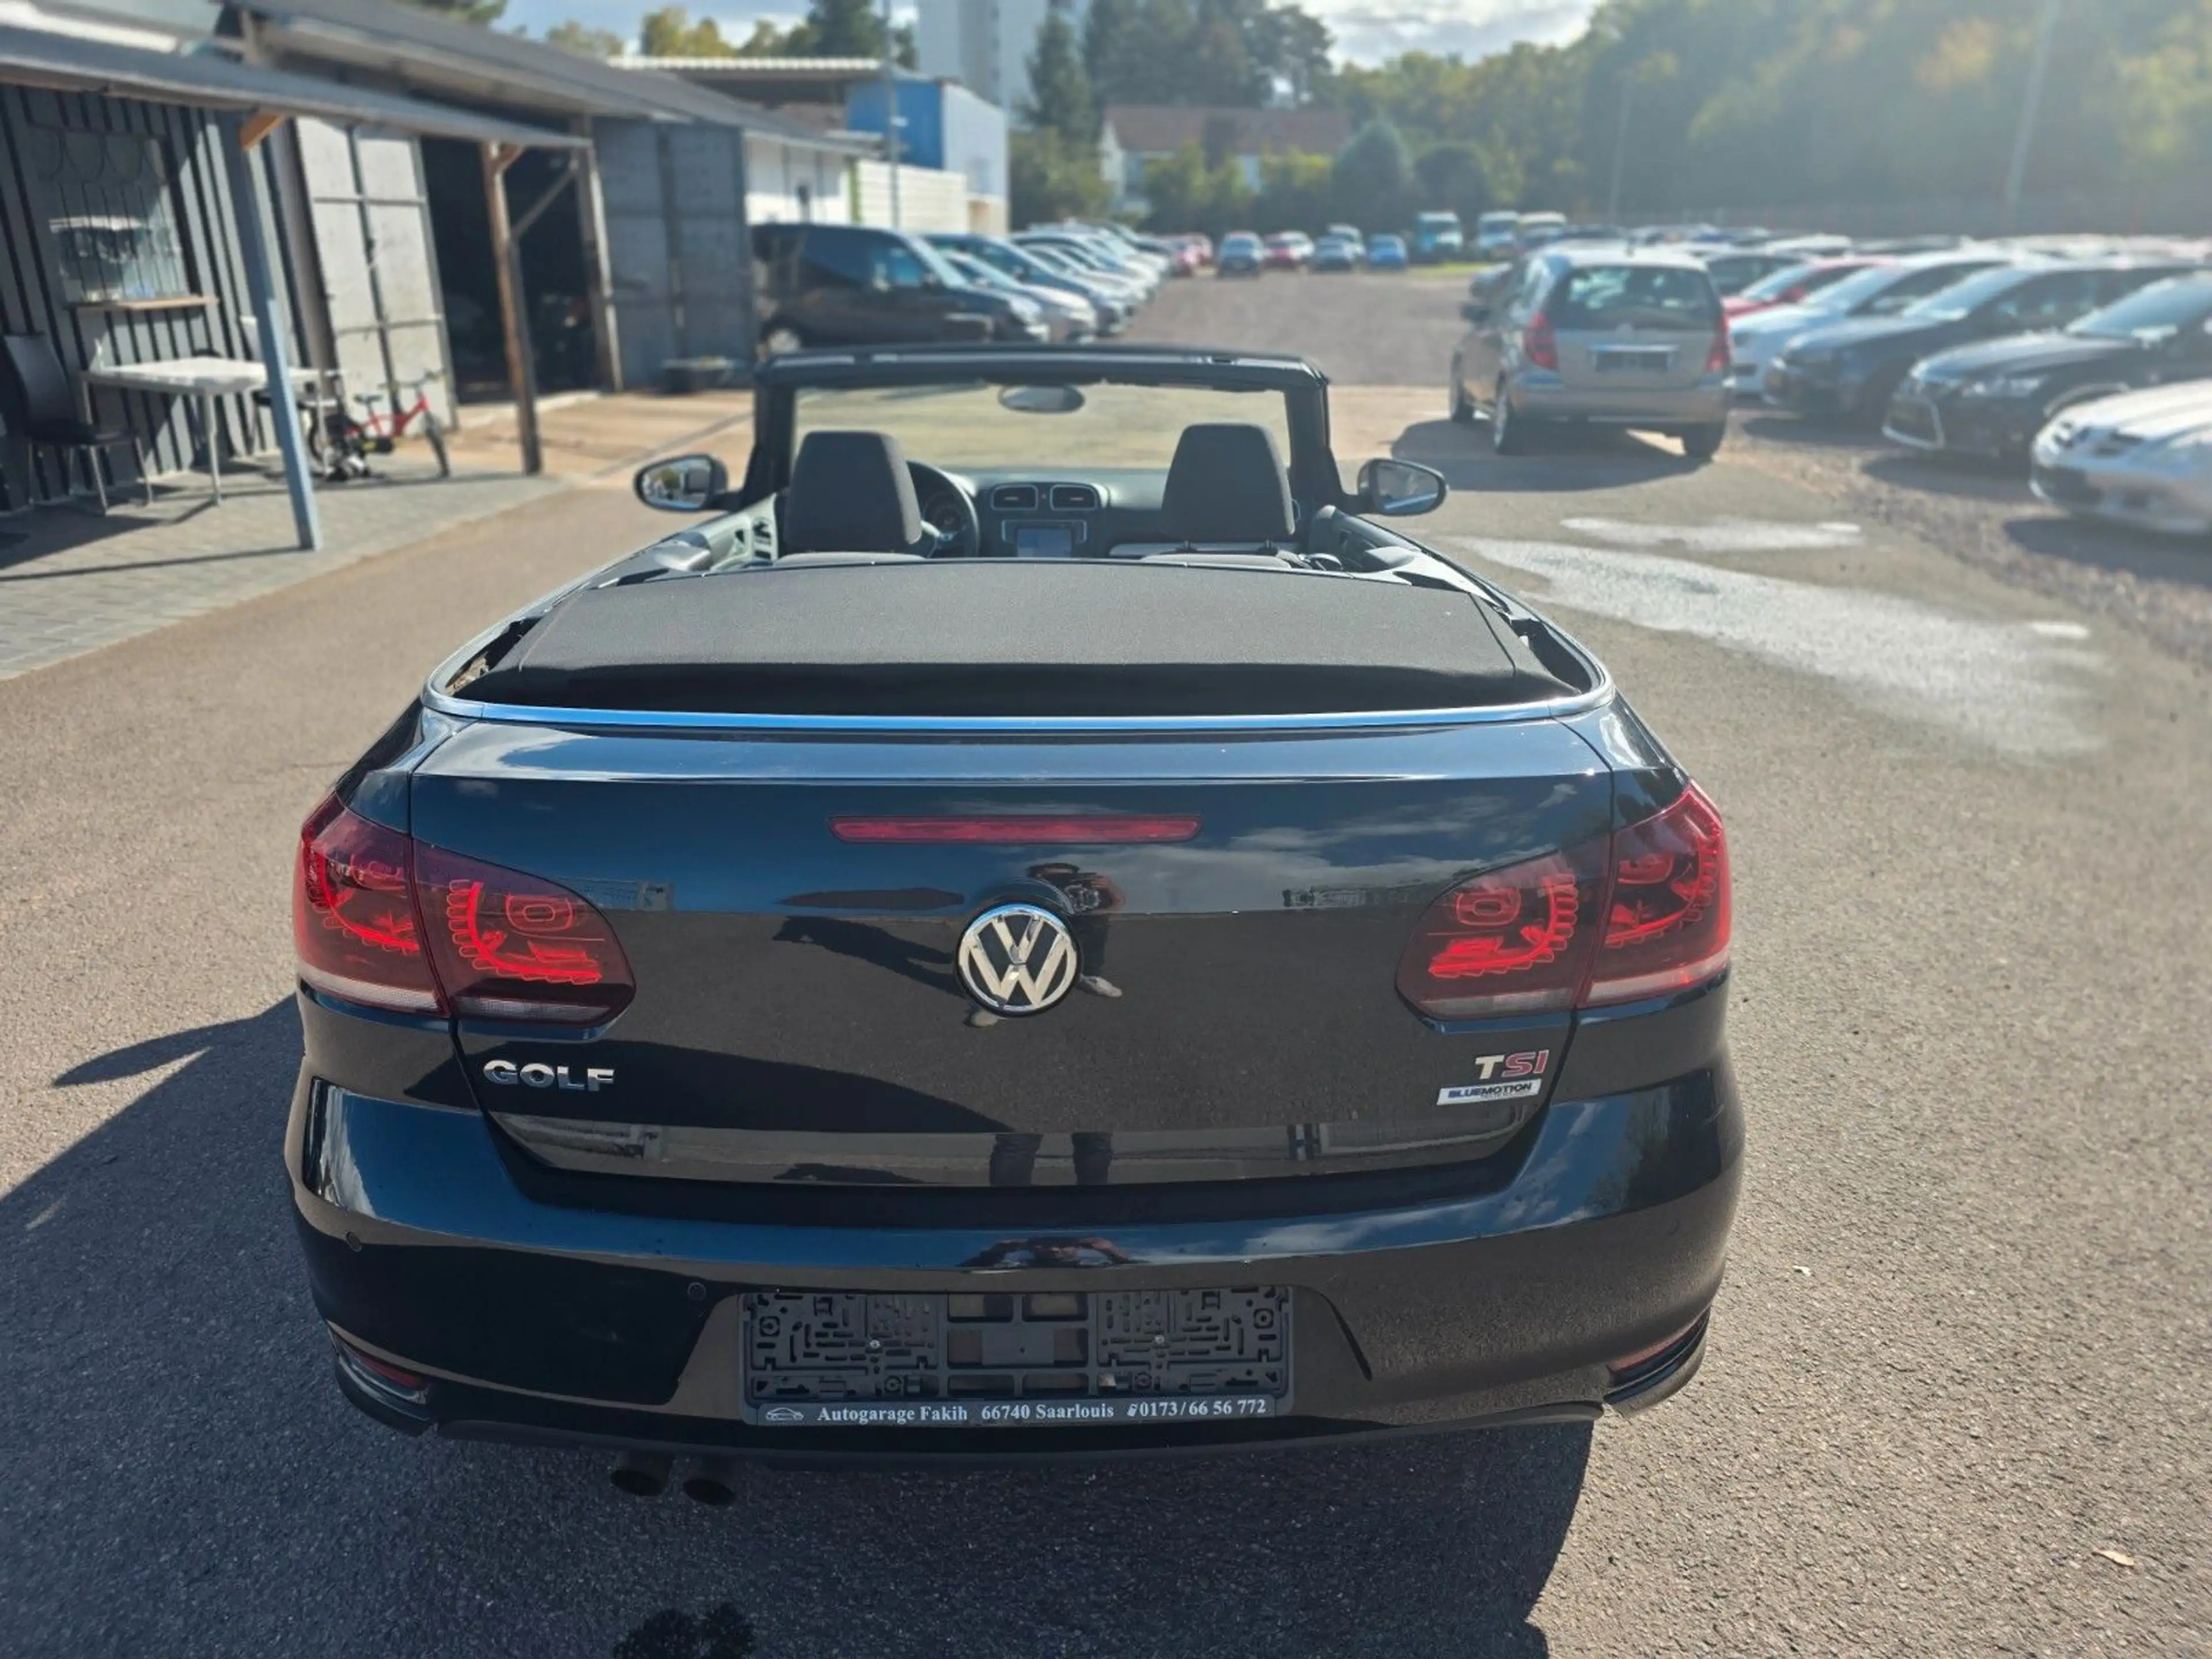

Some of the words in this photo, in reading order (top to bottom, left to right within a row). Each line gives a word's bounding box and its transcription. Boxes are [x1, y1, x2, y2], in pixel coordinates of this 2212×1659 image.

[483, 1059, 614, 1092] GOLF
[1475, 1049, 1550, 1080] TSI
[1448, 1083, 1532, 1098] BLUEMOTION
[817, 1407, 915, 1425] Autogarage
[920, 1406, 968, 1421] Fakih
[981, 1404, 1030, 1419] 66740
[1035, 1403, 1115, 1419] Saarlouis
[1213, 1400, 1233, 1415] 56
[1237, 1399, 1266, 1414] 772
